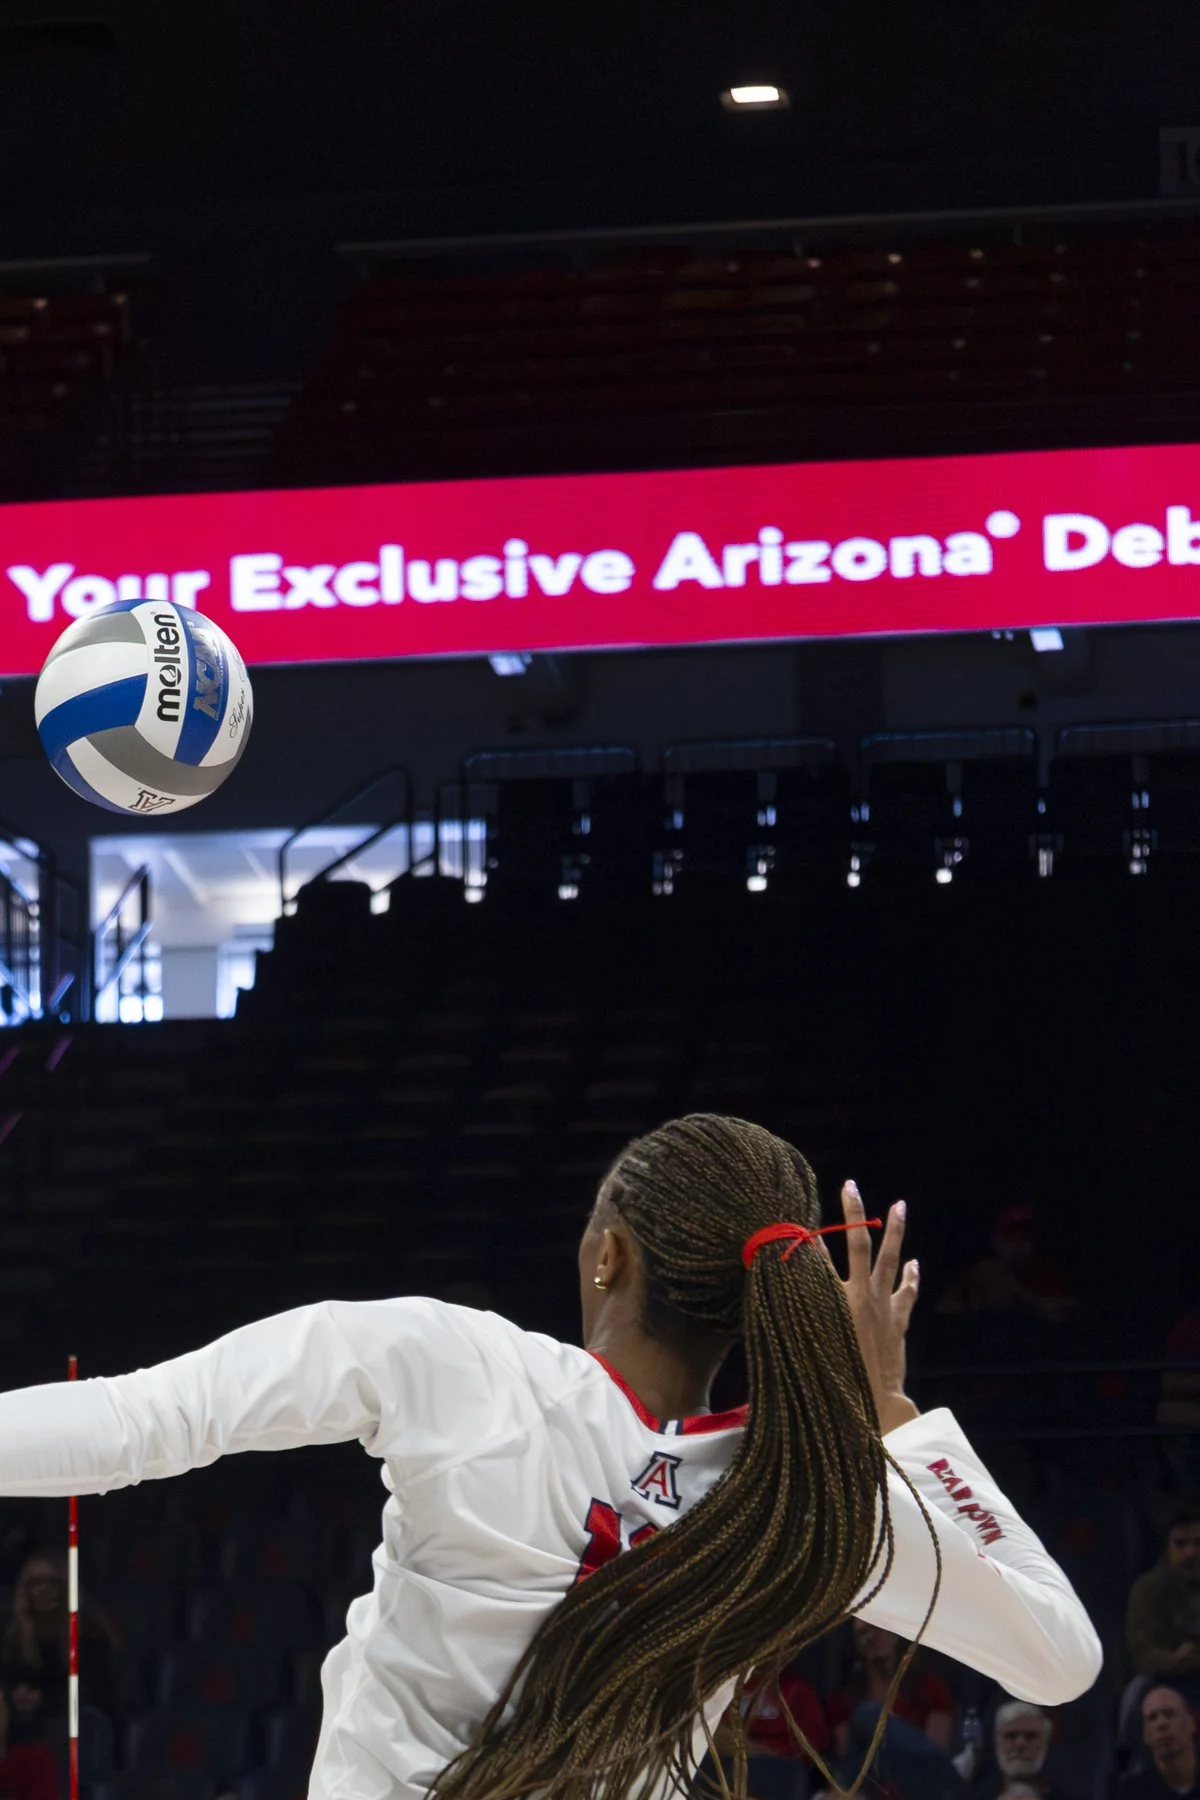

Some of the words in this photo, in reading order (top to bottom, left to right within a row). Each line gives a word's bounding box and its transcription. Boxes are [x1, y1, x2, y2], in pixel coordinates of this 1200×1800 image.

[8, 562, 210, 622] Your
[230, 541, 634, 612] Exclusive
[153, 613, 183, 723] molten
